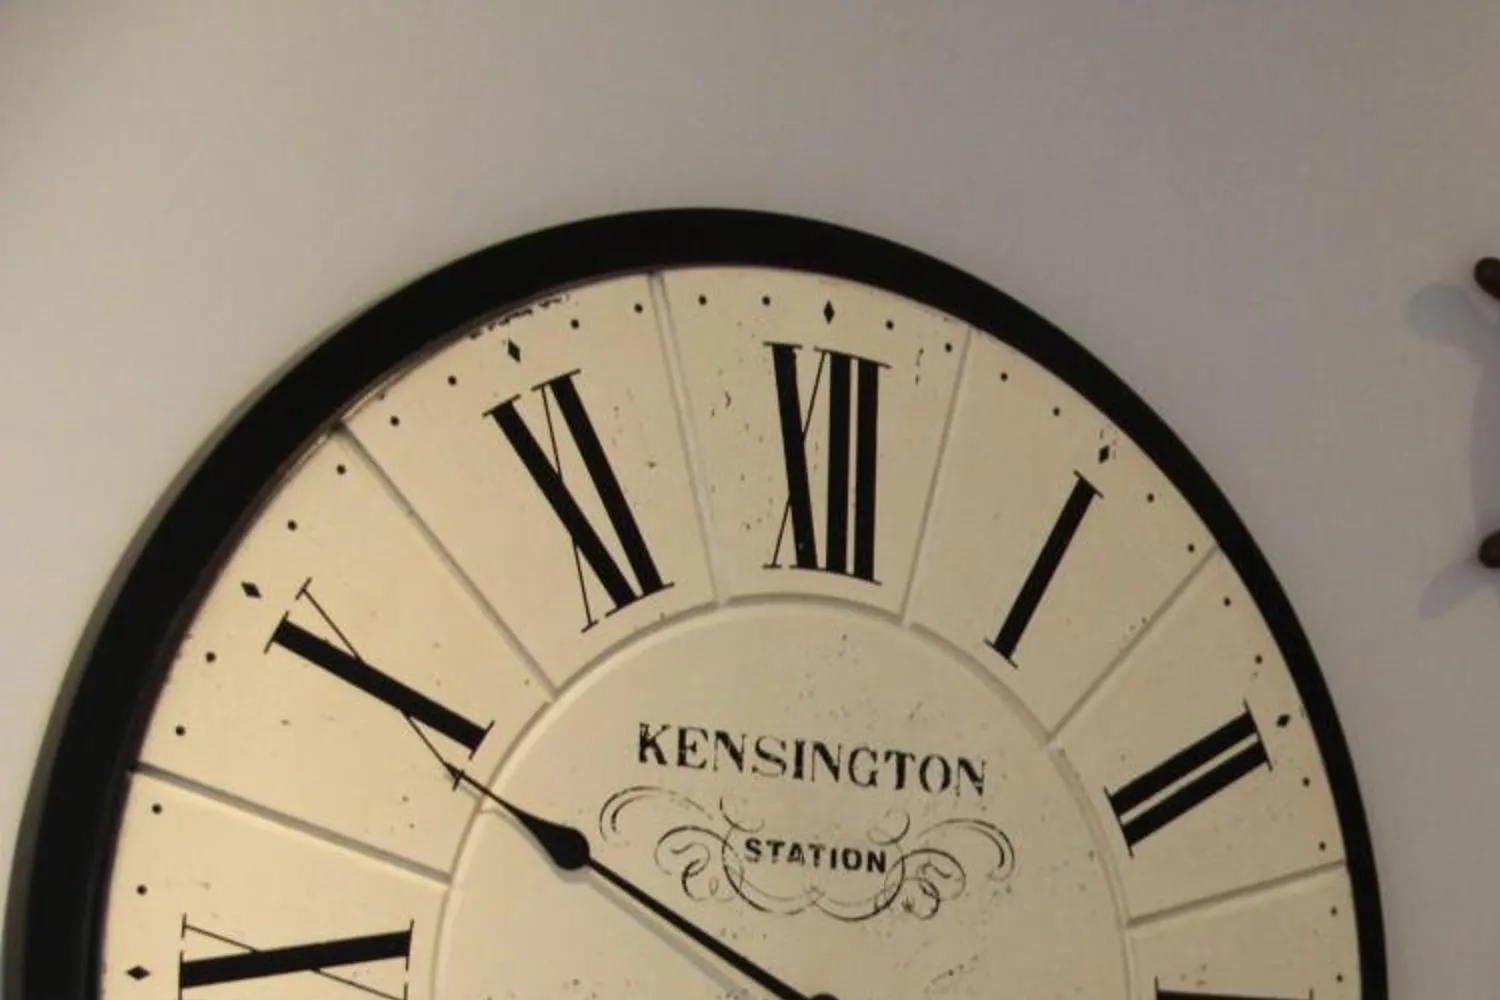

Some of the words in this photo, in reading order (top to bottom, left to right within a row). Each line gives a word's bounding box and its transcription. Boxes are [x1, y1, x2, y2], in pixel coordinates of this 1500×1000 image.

[483, 369, 675, 633] XI
[763, 341, 891, 586] XII
[984, 471, 1104, 669] I
[264, 578, 495, 790] X
[637, 721, 987, 797] KENSINGTON
[1104, 699, 1273, 858] II
[744, 837, 887, 873] STATION
